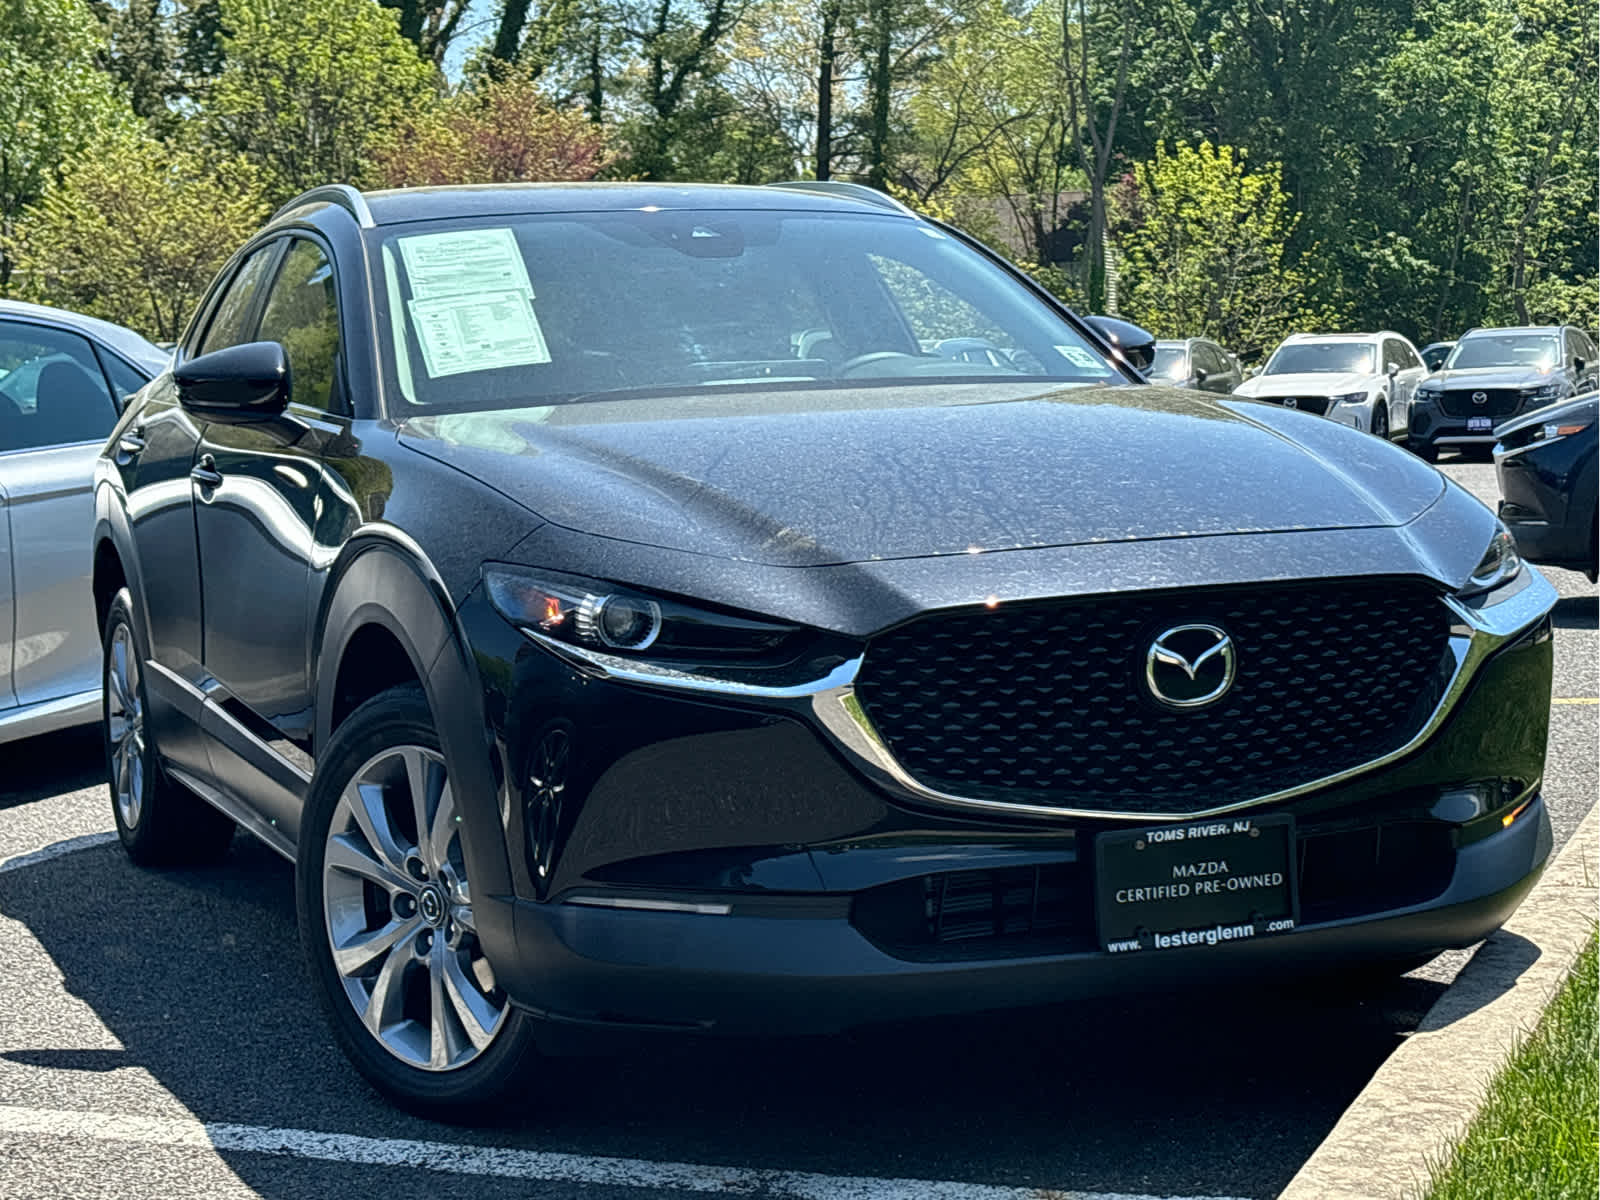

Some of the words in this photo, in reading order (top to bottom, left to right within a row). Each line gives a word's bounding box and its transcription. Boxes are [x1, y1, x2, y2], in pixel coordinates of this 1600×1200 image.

[1146, 829, 1185, 843] TOMS
[1233, 821, 1250, 833] NJ
[1172, 861, 1229, 878] MAZDA
[1115, 883, 1190, 903] CERTIFIED
[1194, 872, 1283, 895] PRE-OWNED
[1108, 940, 1142, 953] www.
[1154, 924, 1254, 948] lesterglenn
